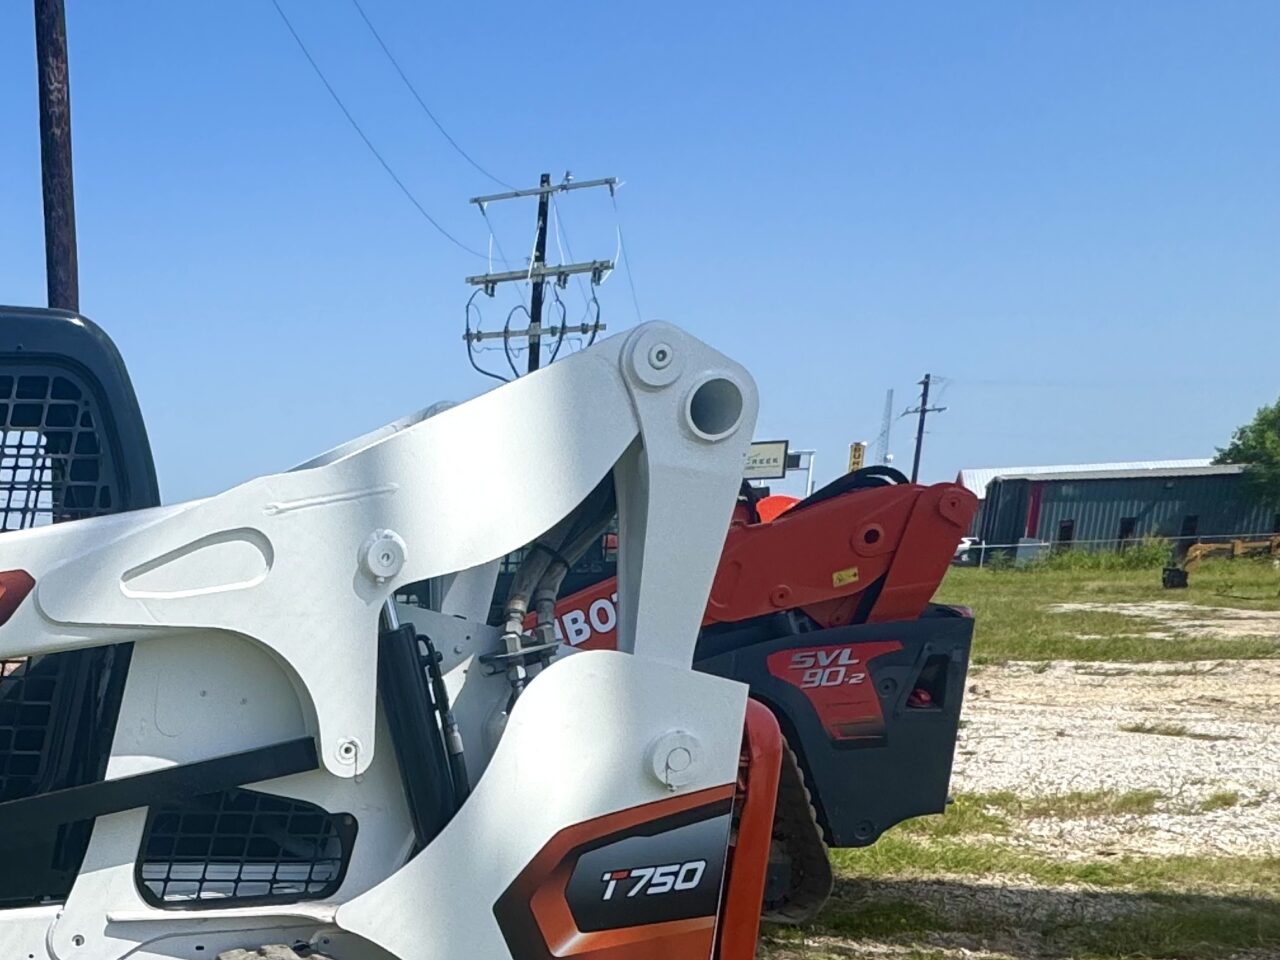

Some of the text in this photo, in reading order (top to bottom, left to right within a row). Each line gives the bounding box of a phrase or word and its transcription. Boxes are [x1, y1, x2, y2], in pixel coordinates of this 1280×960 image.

[788, 648, 860, 669] SVL
[800, 666, 866, 689] 90-2
[602, 860, 707, 901] T750
